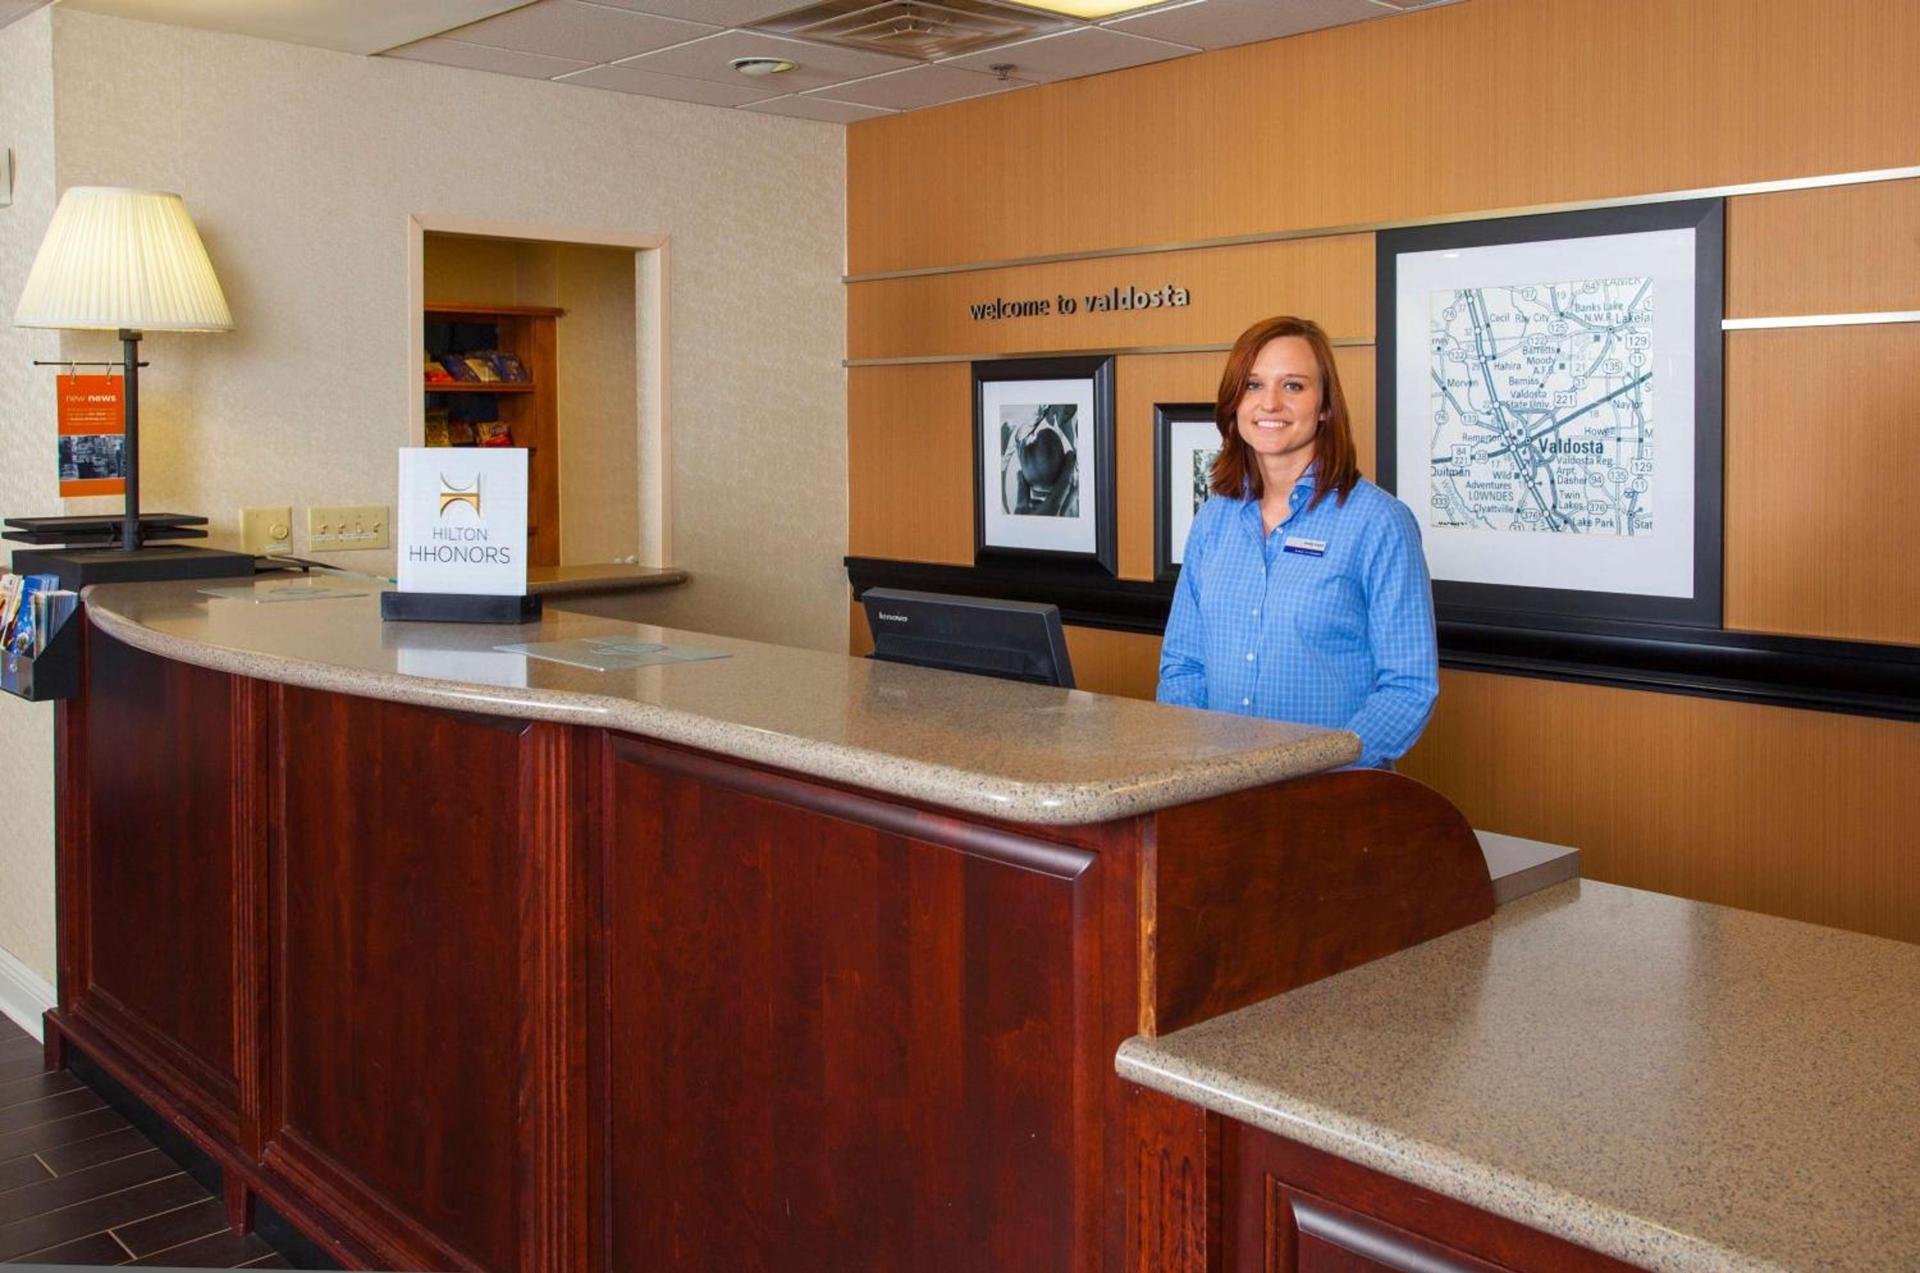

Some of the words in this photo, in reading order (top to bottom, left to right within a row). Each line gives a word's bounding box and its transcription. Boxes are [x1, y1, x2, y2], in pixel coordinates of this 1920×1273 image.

[969, 297, 1050, 320] welcome
[1057, 294, 1077, 315] to
[1085, 284, 1190, 313] valdosta
[1490, 312, 1510, 322] Cecil
[1533, 312, 1549, 324] City
[1629, 336, 1648, 346] 129
[1526, 356, 1556, 366] Moody
[88, 394, 117, 403] news
[1511, 389, 1547, 399] Valdosta
[1556, 394, 1573, 404] 221
[1538, 438, 1604, 454] Valdosta
[1556, 455, 1594, 464] Valdosta
[1635, 462, 1652, 472] 129
[1492, 470, 1512, 480] Wild
[1466, 480, 1512, 490] Adventures
[1468, 492, 1514, 501] LOWNDES
[1560, 490, 1580, 500] Twin
[1560, 500, 1584, 510] Lakes
[1572, 518, 1592, 528] Lake
[1594, 518, 1614, 528] Park
[432, 527, 488, 542] HILTON
[409, 545, 511, 564] HHONORS
[879, 611, 908, 622] lenovo
